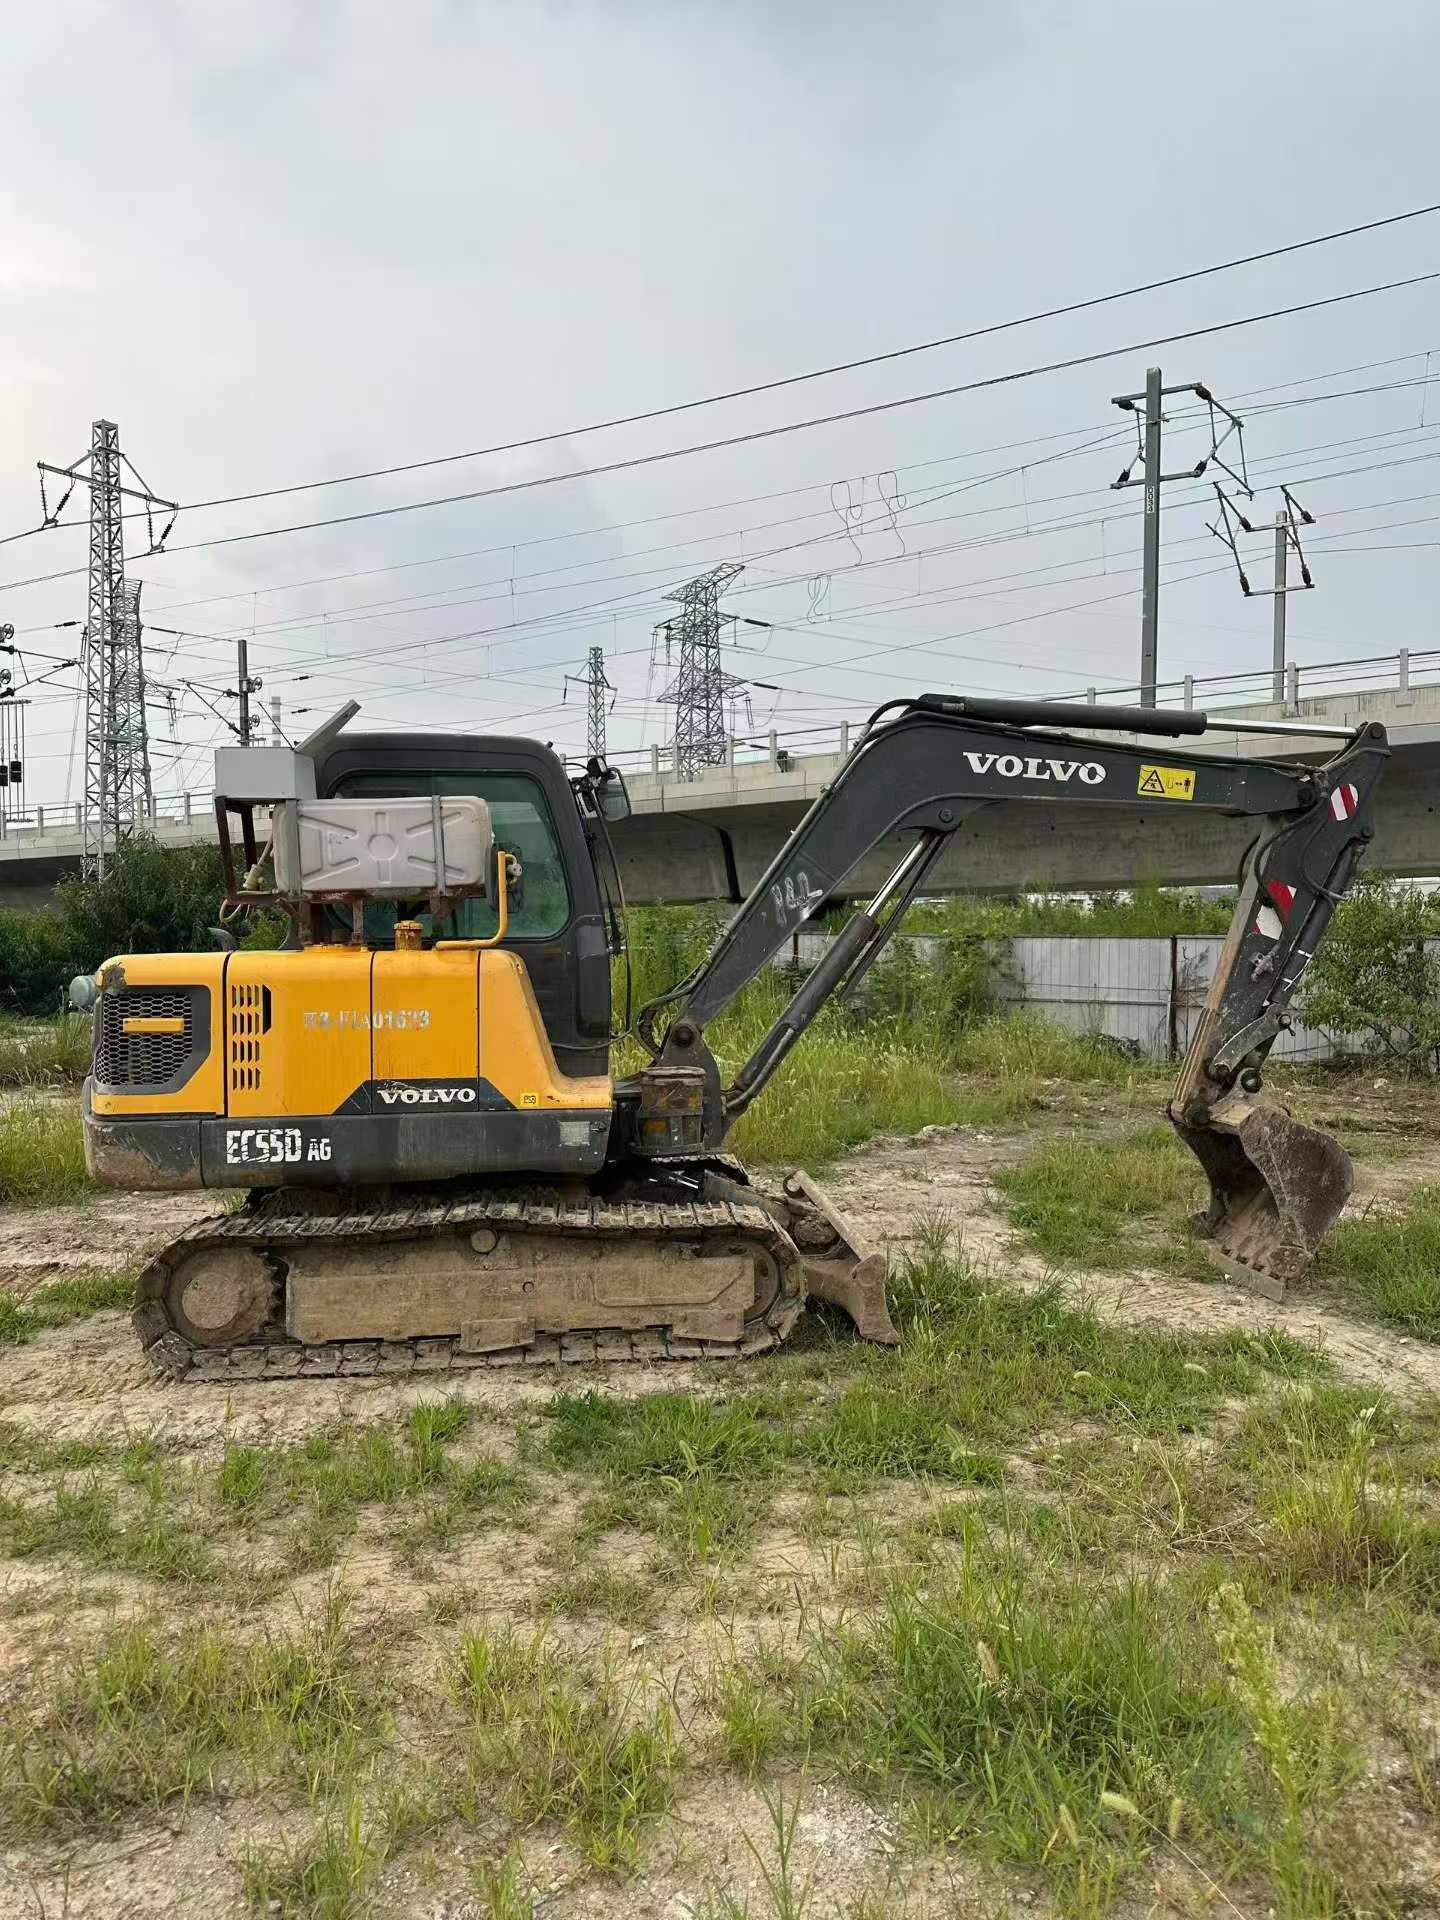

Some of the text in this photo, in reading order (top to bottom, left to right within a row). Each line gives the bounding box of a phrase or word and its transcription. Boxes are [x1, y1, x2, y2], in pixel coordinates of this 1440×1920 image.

[963, 752, 1107, 785] VOLVO
[377, 1087, 476, 1105] VOLVO
[307, 1138, 332, 1161] AG
